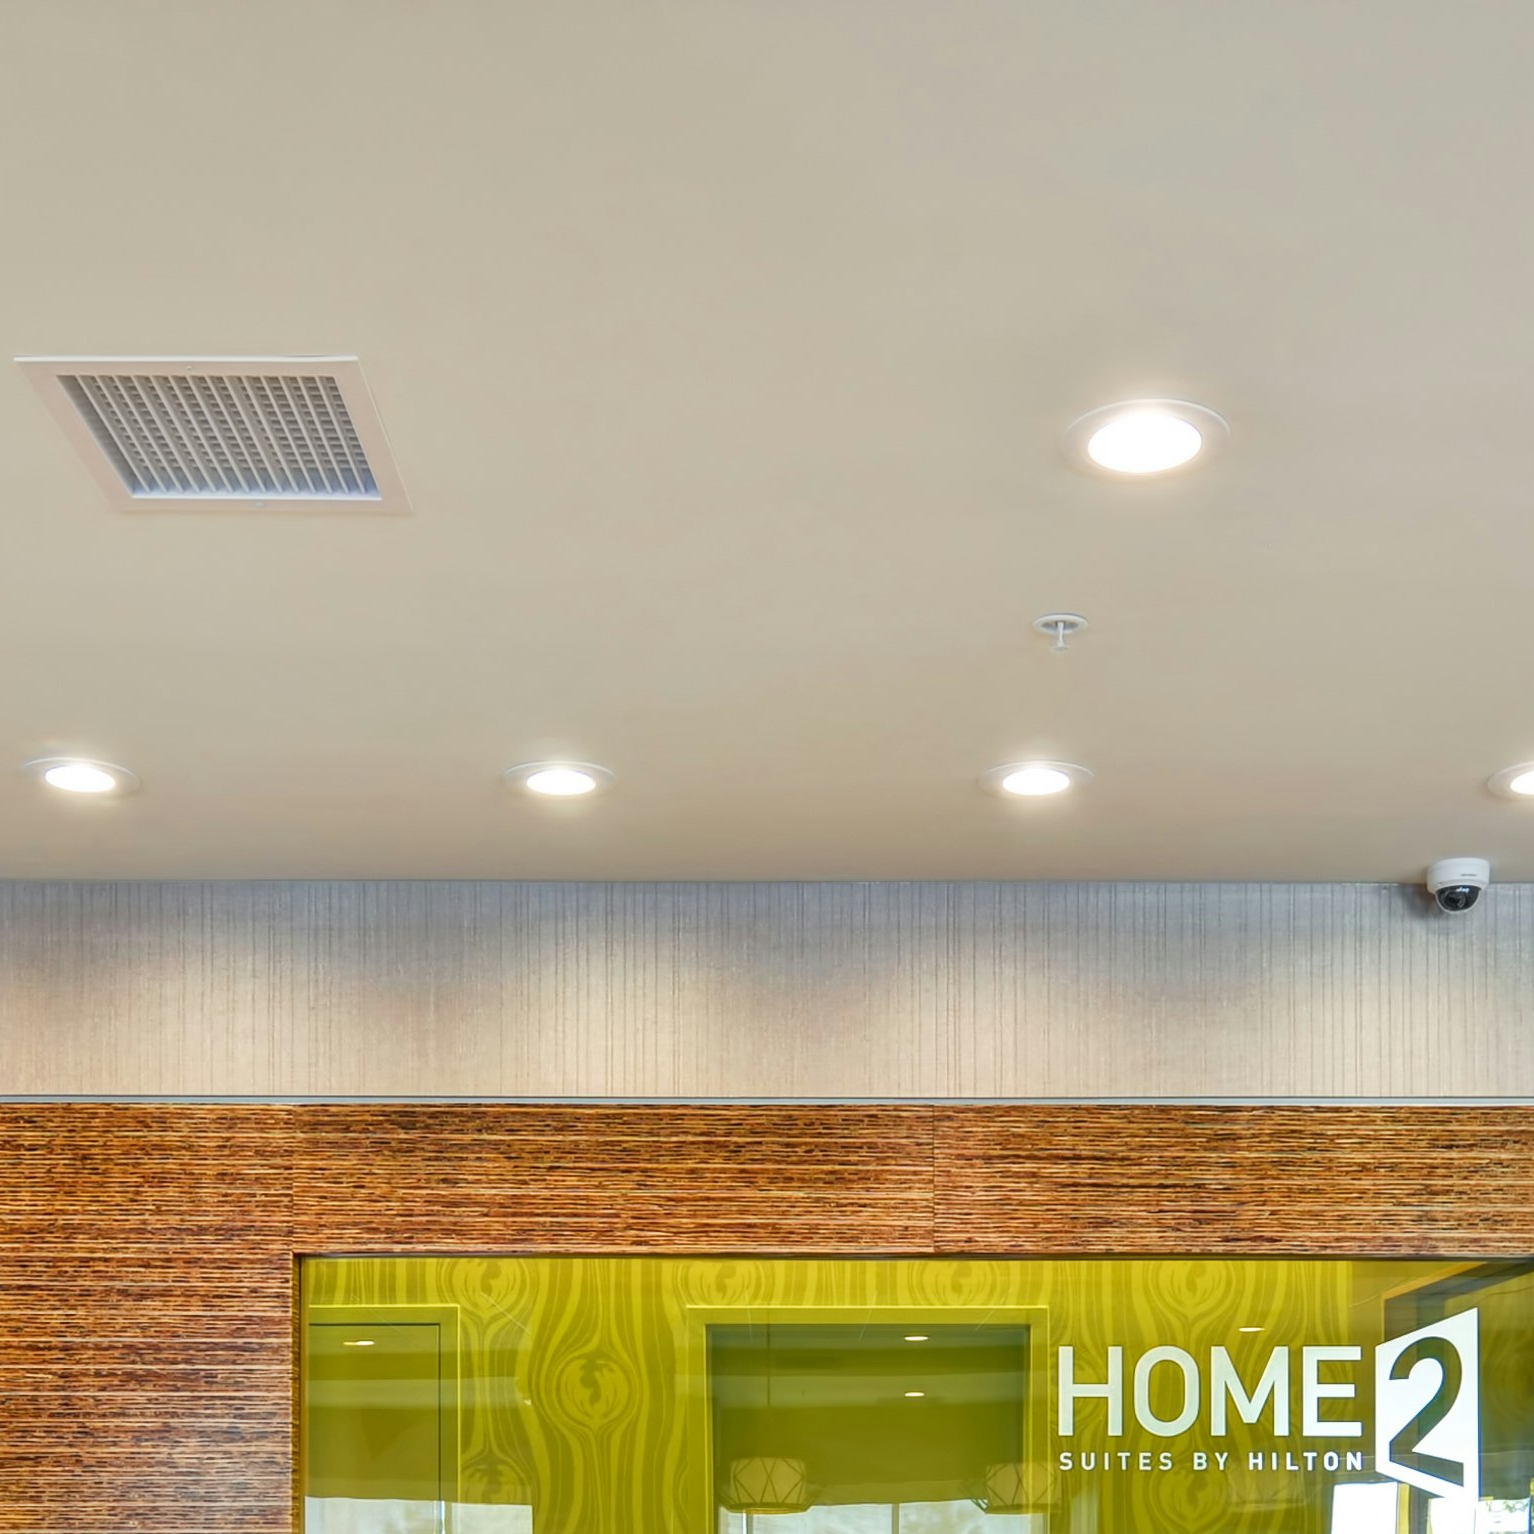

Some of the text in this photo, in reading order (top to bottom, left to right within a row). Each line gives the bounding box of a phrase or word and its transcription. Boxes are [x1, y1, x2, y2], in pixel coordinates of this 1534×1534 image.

[1057, 1336, 1464, 1487] HOME 2
[1058, 1450, 1363, 1472] SUITES BY HILTON
